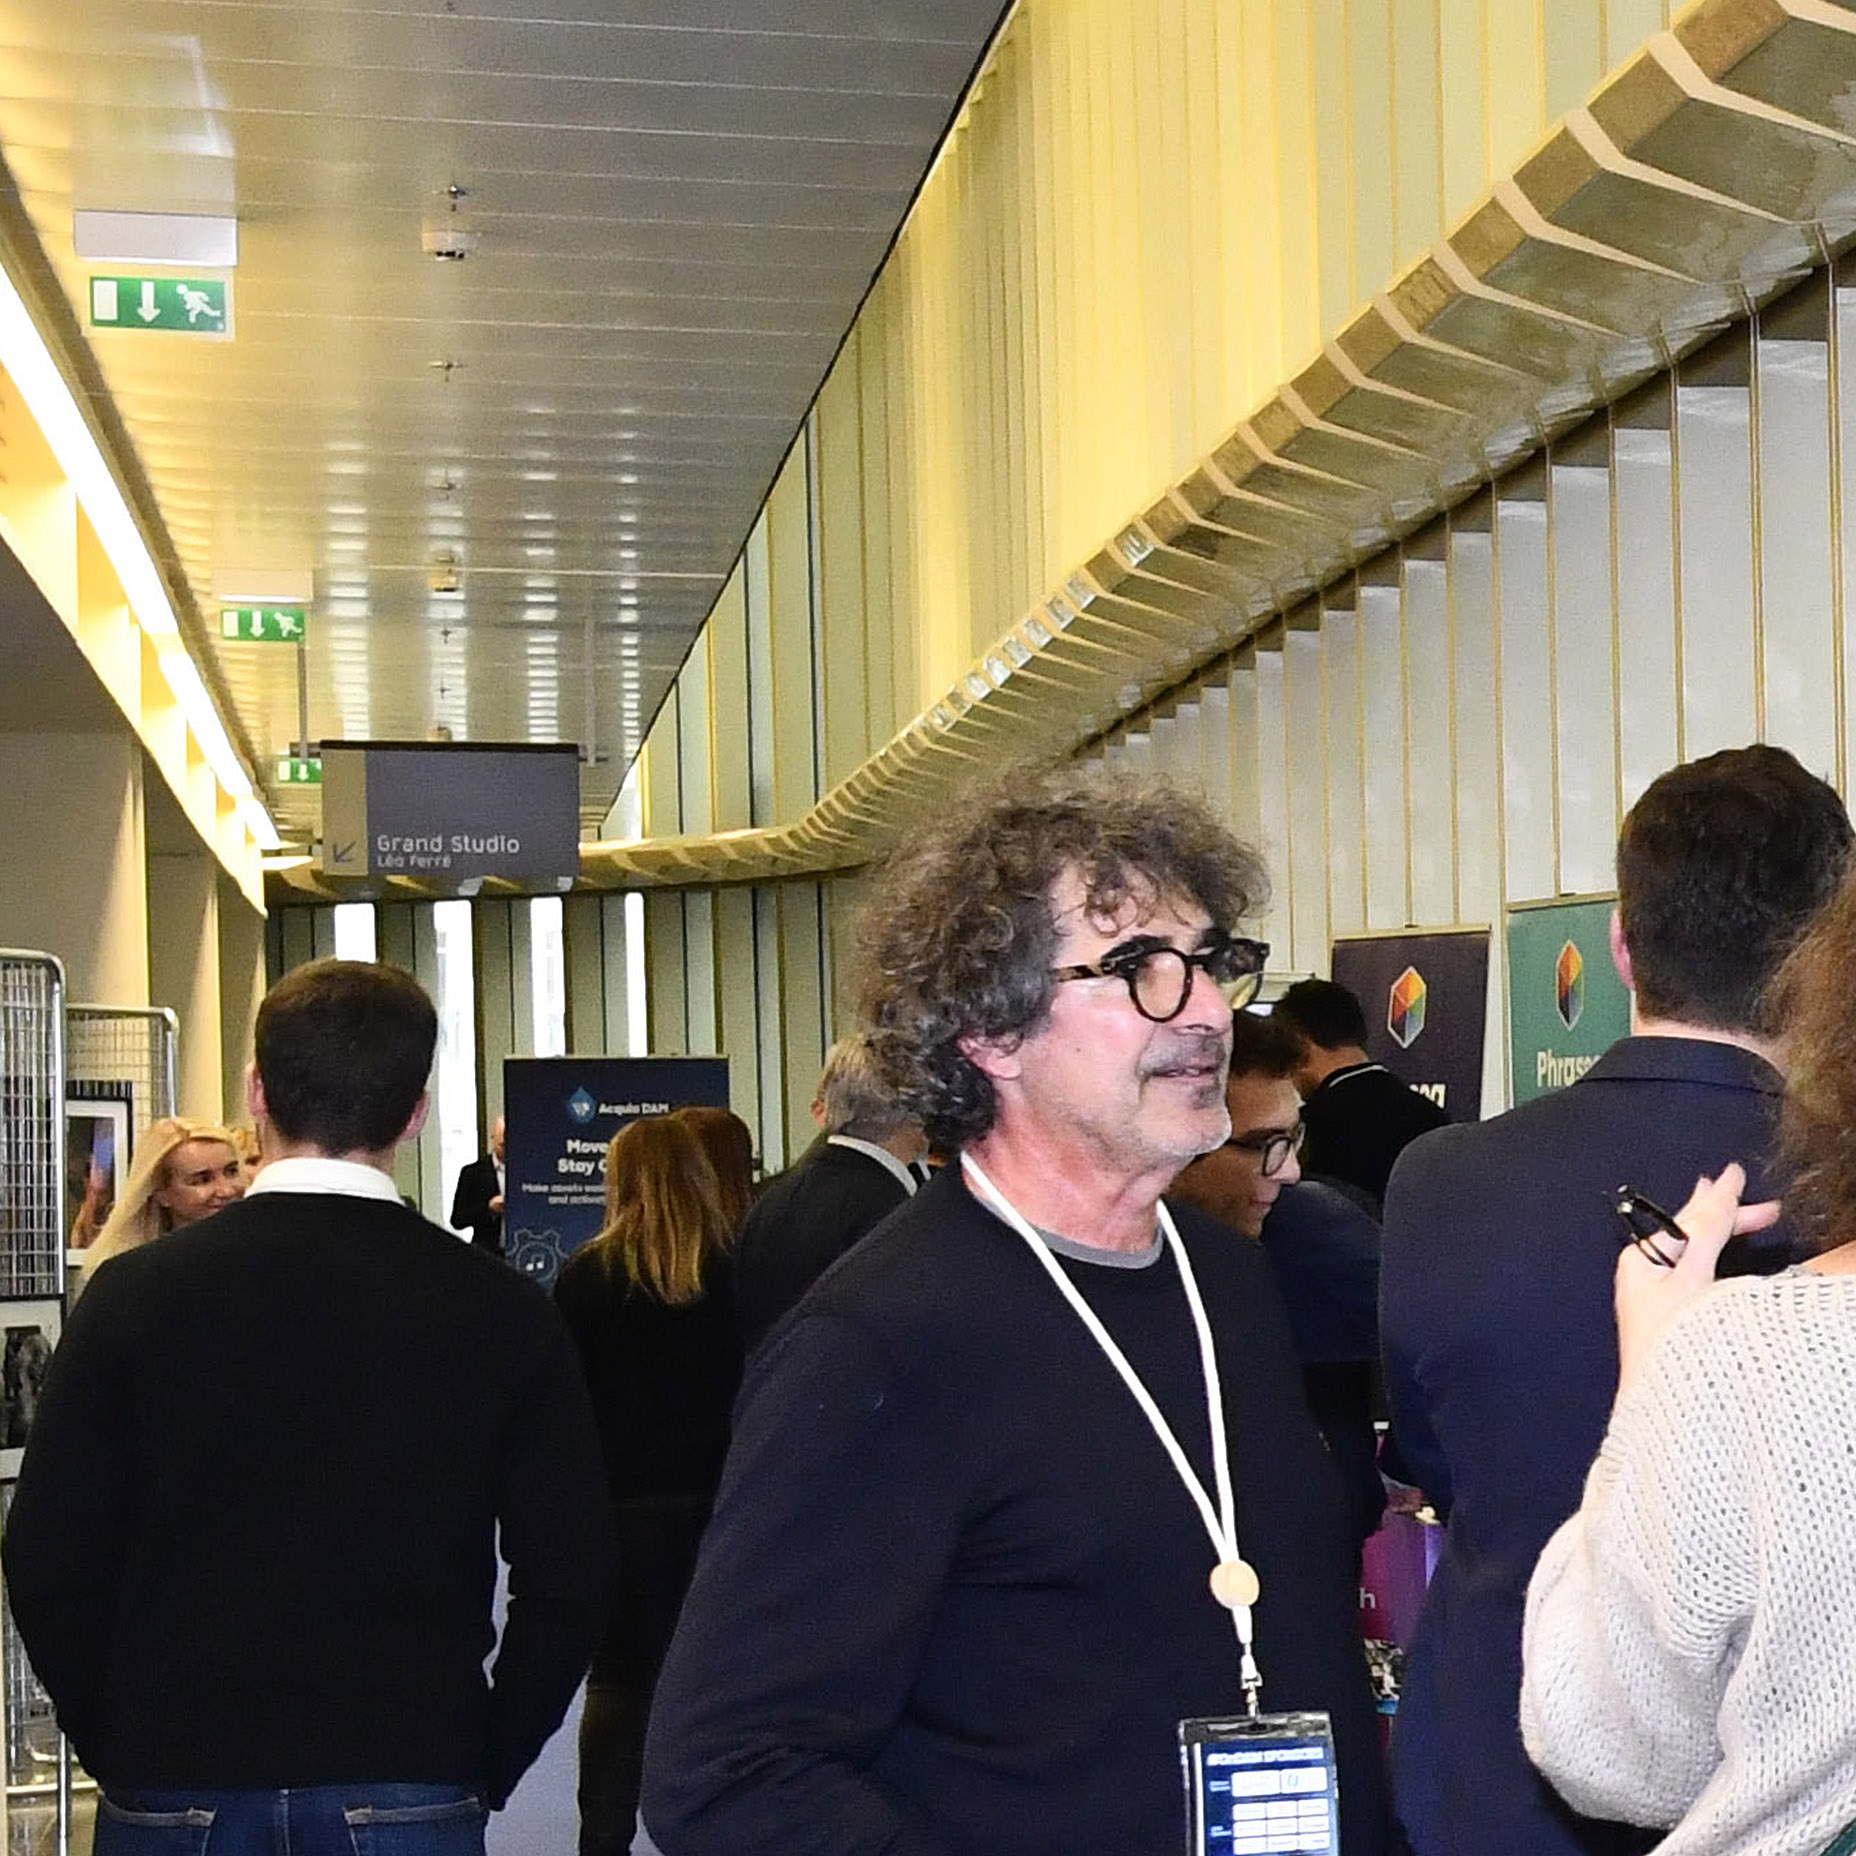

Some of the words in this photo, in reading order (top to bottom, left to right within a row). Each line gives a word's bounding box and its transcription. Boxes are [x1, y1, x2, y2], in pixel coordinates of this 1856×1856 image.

[377, 834, 443, 853] Grand
[451, 834, 521, 854] Studio
[642, 1102, 669, 1114] DAM
[557, 1158, 594, 1175] Stay
